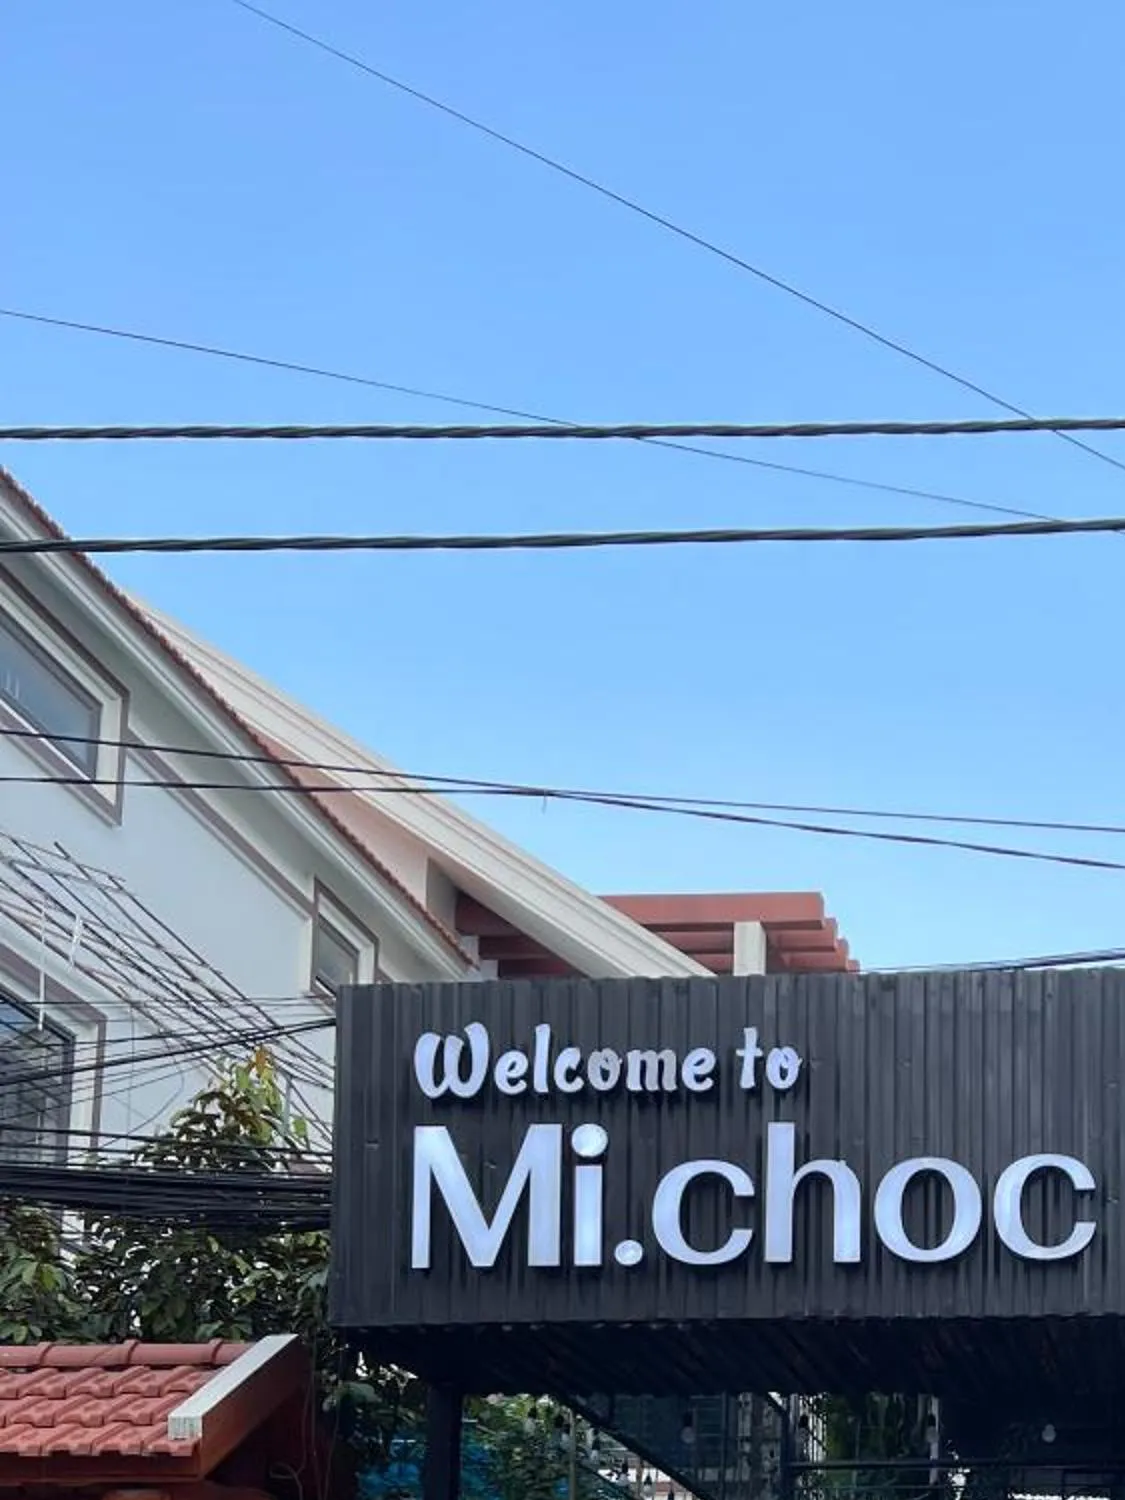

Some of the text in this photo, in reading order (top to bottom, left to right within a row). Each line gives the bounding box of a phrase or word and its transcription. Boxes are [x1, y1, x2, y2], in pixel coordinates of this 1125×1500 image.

[414, 1021, 802, 1099] Welcome to
[411, 1121, 1098, 1271] Mi.choc
